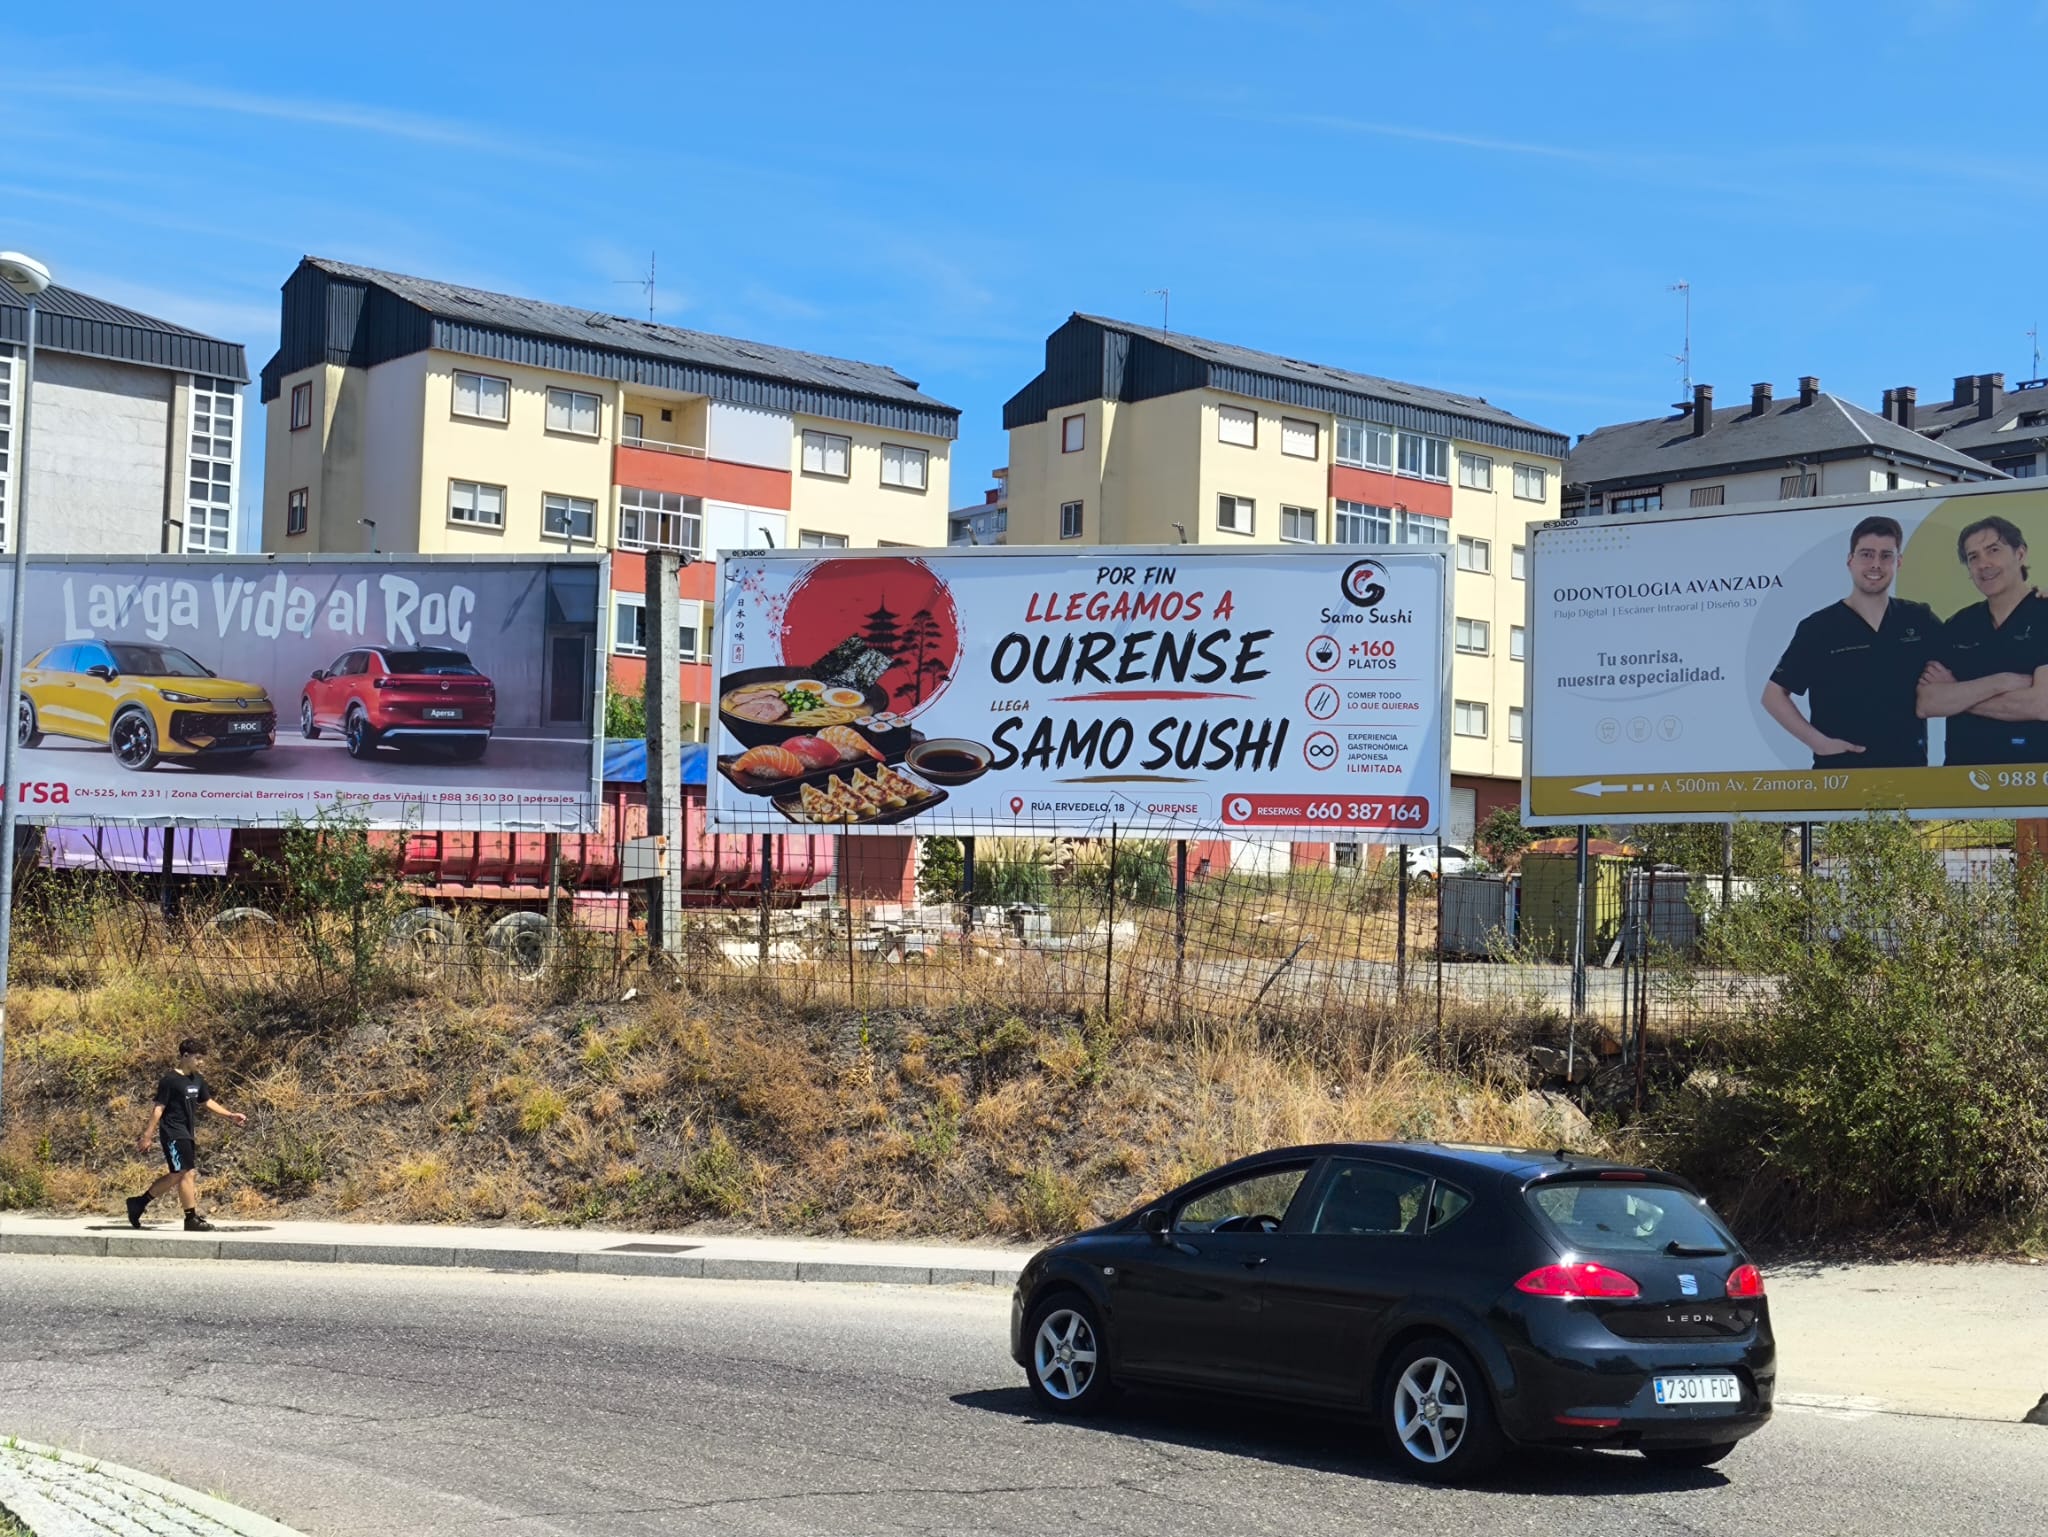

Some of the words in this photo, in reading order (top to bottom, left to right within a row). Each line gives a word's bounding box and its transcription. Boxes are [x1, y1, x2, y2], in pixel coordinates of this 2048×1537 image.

[1096, 567, 1136, 585] POR
[1143, 567, 1176, 585] FIN
[1553, 581, 1682, 602] ODONTOLOGIA
[1685, 574, 1784, 594] AVANZADA
[63, 577, 199, 641] Larga
[212, 570, 315, 640] Vida
[327, 579, 367, 636] al
[1025, 591, 1204, 623] LLEGAMOS
[1212, 590, 1235, 622] A
[1554, 608, 1576, 620] Flujo
[1578, 607, 1608, 619] Digital
[1657, 601, 1698, 613] Intraoral
[1706, 599, 1740, 610] Diseño
[1743, 597, 1758, 608] 3D
[735, 598, 745, 641] 日本の味
[1320, 607, 1364, 624] Samo
[1368, 607, 1413, 624] Sushi
[1348, 640, 1395, 657] +160
[990, 628, 1275, 685] OURENSE
[1348, 658, 1397, 669] PLATOS
[1597, 651, 1617, 667] Tu
[1620, 649, 1683, 666] sonrisa,
[1557, 673, 1616, 688] nuestra
[1619, 667, 1726, 688] especialidad.
[1347, 692, 1377, 700] COMER
[1379, 692, 1402, 700] TODO
[990, 700, 1030, 712] LLEGA
[1347, 702, 1359, 710] LO
[1360, 702, 1380, 710] QUE
[1382, 702, 1420, 710] QUIERAS
[430, 709, 456, 718] Apersa
[233, 722, 257, 731] T-ROC
[985, 716, 1134, 771] SAMO
[1140, 717, 1290, 772] SUSHI
[1348, 733, 1398, 741] EXPERIENCIA
[1348, 753, 1389, 761] JAPONESA
[1347, 764, 1402, 774] ILIMITADA
[1660, 780, 1672, 793] A
[1676, 778, 1720, 793] 500m
[1725, 778, 1748, 792] Av.
[1752, 777, 1818, 792] Zamora,
[1823, 775, 1849, 789] 107
[1998, 771, 2037, 787] 988
[74, 788, 118, 798] CN-525,
[121, 788, 138, 797] km
[141, 789, 162, 798] 231
[171, 789, 198, 798] Zona
[200, 790, 253, 799] Comercial
[256, 790, 304, 799] Barreiros
[313, 790, 333, 799] San
[372, 792, 391, 800] das
[440, 793, 462, 802] 988
[465, 794, 478, 802] 36
[482, 794, 497, 802] 30
[499, 794, 514, 802] 30
[523, 795, 575, 804] apersaes
[1031, 801, 1051, 812] RÚA
[1055, 803, 1111, 814] ERVEDELO,
[1114, 804, 1125, 812] 18
[1147, 804, 1198, 813] OURENSE
[1257, 807, 1302, 816] RESERVAS:
[1306, 802, 1342, 819] 660
[1347, 802, 1383, 820] 387
[1388, 804, 1421, 821] 164
[1667, 1379, 1705, 1399] 7301
[1711, 1379, 1735, 1398] FDF
